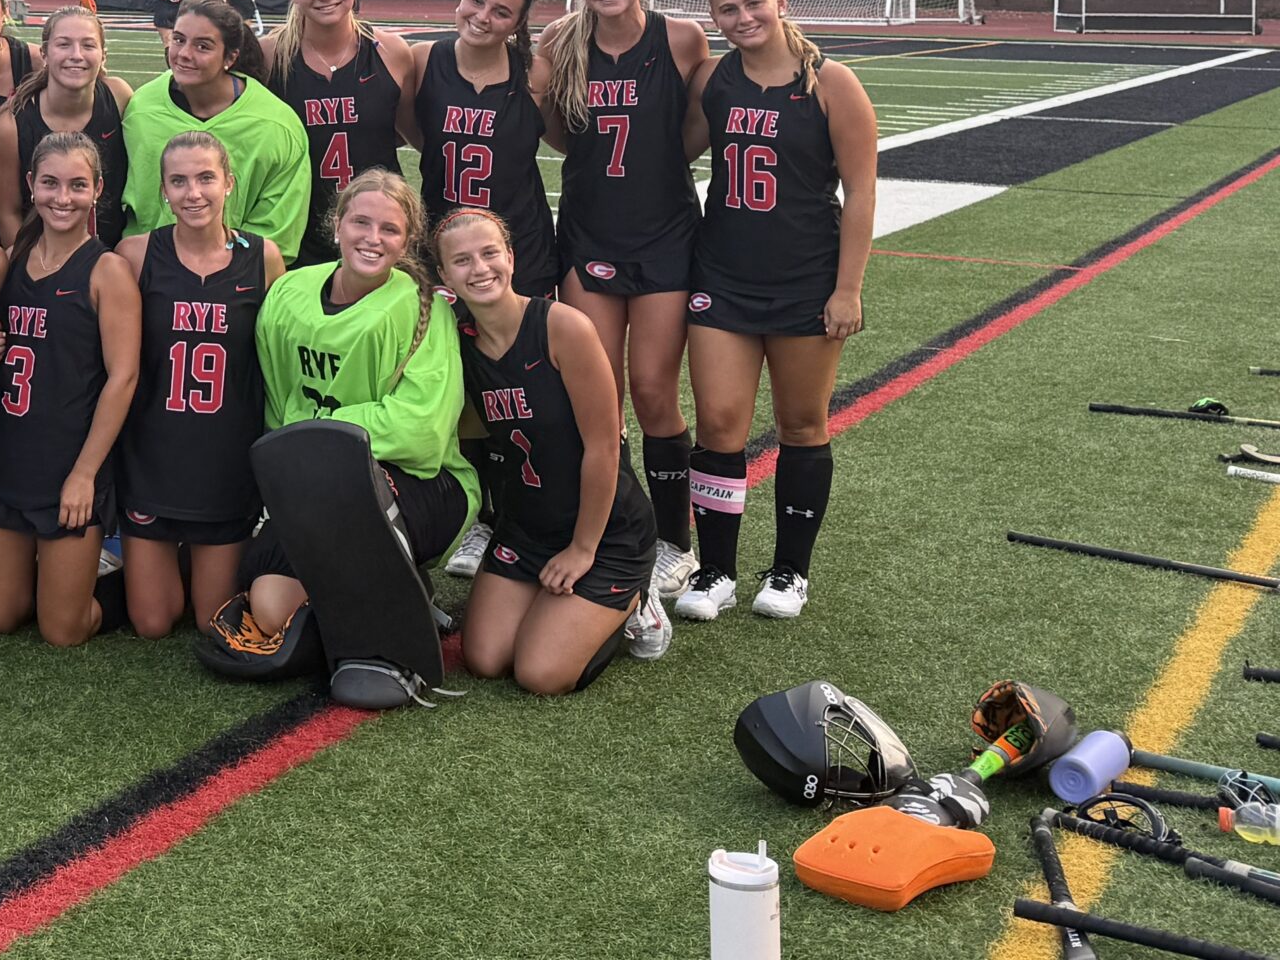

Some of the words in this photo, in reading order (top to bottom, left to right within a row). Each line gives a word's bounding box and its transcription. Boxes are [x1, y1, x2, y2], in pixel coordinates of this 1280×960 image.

[587, 80, 638, 107] RYE
[304, 96, 359, 126] RYE
[442, 105, 497, 137] RYE
[725, 107, 780, 138] RYE
[320, 132, 353, 193] 4
[597, 115, 630, 177] 7
[442, 141, 493, 208] 12
[723, 143, 777, 212] 16
[8, 305, 47, 339] RYE
[172, 301, 229, 334] RYE
[165, 340, 227, 414] 19
[297, 345, 341, 381] RYE
[1, 344, 36, 417] 3
[482, 387, 533, 422] RYE
[657, 468, 688, 480] STX
[690, 480, 734, 499] CAPTAIN
[820, 683, 838, 704] OBO
[803, 774, 818, 799] OBO
